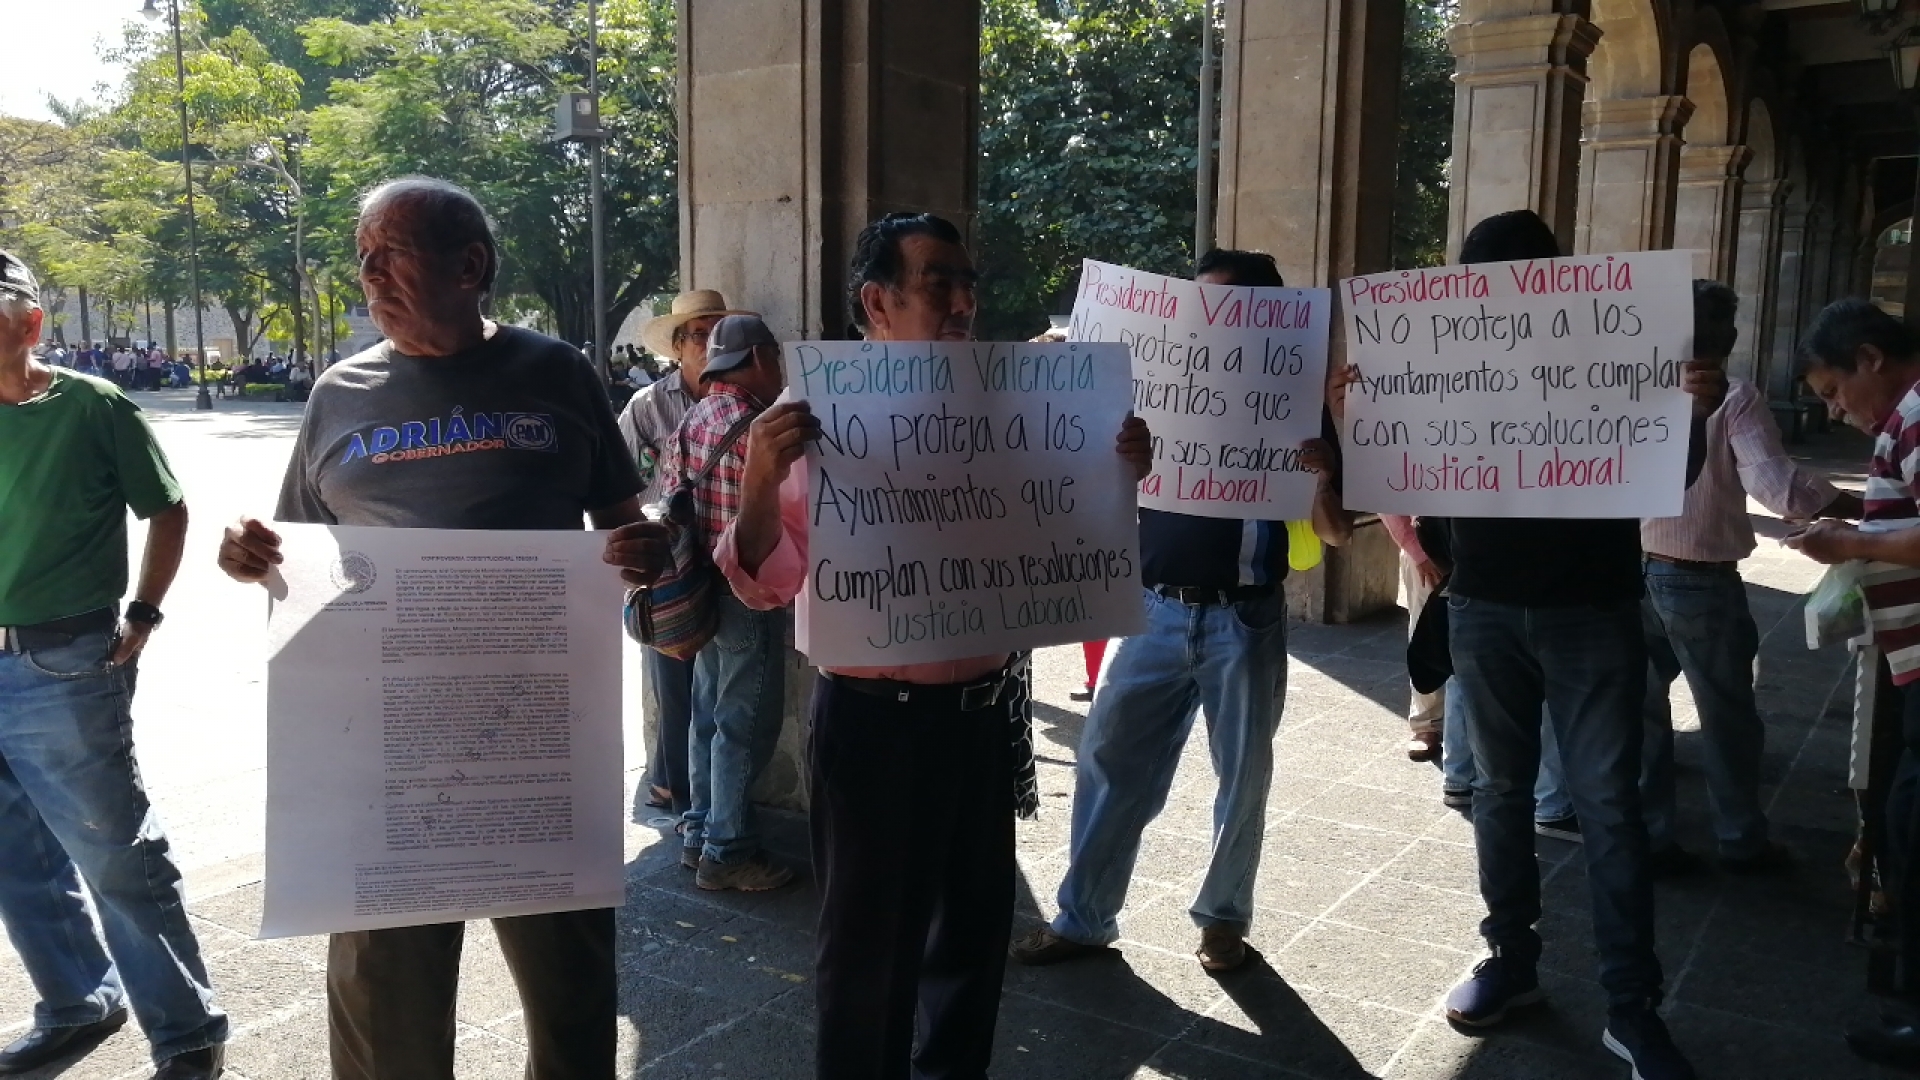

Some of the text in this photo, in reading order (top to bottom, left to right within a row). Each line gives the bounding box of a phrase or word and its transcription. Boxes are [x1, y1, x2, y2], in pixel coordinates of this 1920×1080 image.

[1083, 264, 1311, 329] Presidenta Valencia
[1347, 256, 1632, 305] Presidenta Valencia
[1431, 304, 1532, 354] proteja
[1552, 308, 1571, 338] a
[1593, 298, 1642, 336] los
[796, 345, 1096, 397] Presidenta Valencia
[1223, 346, 1243, 373] a
[1262, 337, 1303, 376] los
[1348, 360, 1518, 403] Ayuntamientos
[1531, 363, 1577, 401] que
[1245, 391, 1291, 425] que
[1352, 404, 1670, 447] con sus resoluciones
[339, 405, 549, 466] ADRIÁN PAN
[371, 438, 507, 465] GOBERNADOR
[890, 403, 995, 471] proteja
[1006, 413, 1029, 451] a
[1044, 402, 1086, 452] los
[1171, 440, 1211, 467] sus
[1177, 466, 1272, 503] Laboral.
[1387, 445, 1631, 493] Justicia Laboral.
[814, 466, 1006, 536] Ayuntamientos
[1021, 475, 1076, 526] que
[940, 556, 977, 593] con
[980, 555, 1014, 590] sus
[1021, 537, 1133, 592] resoluciones
[867, 585, 1093, 650] Justicia Laboral.
